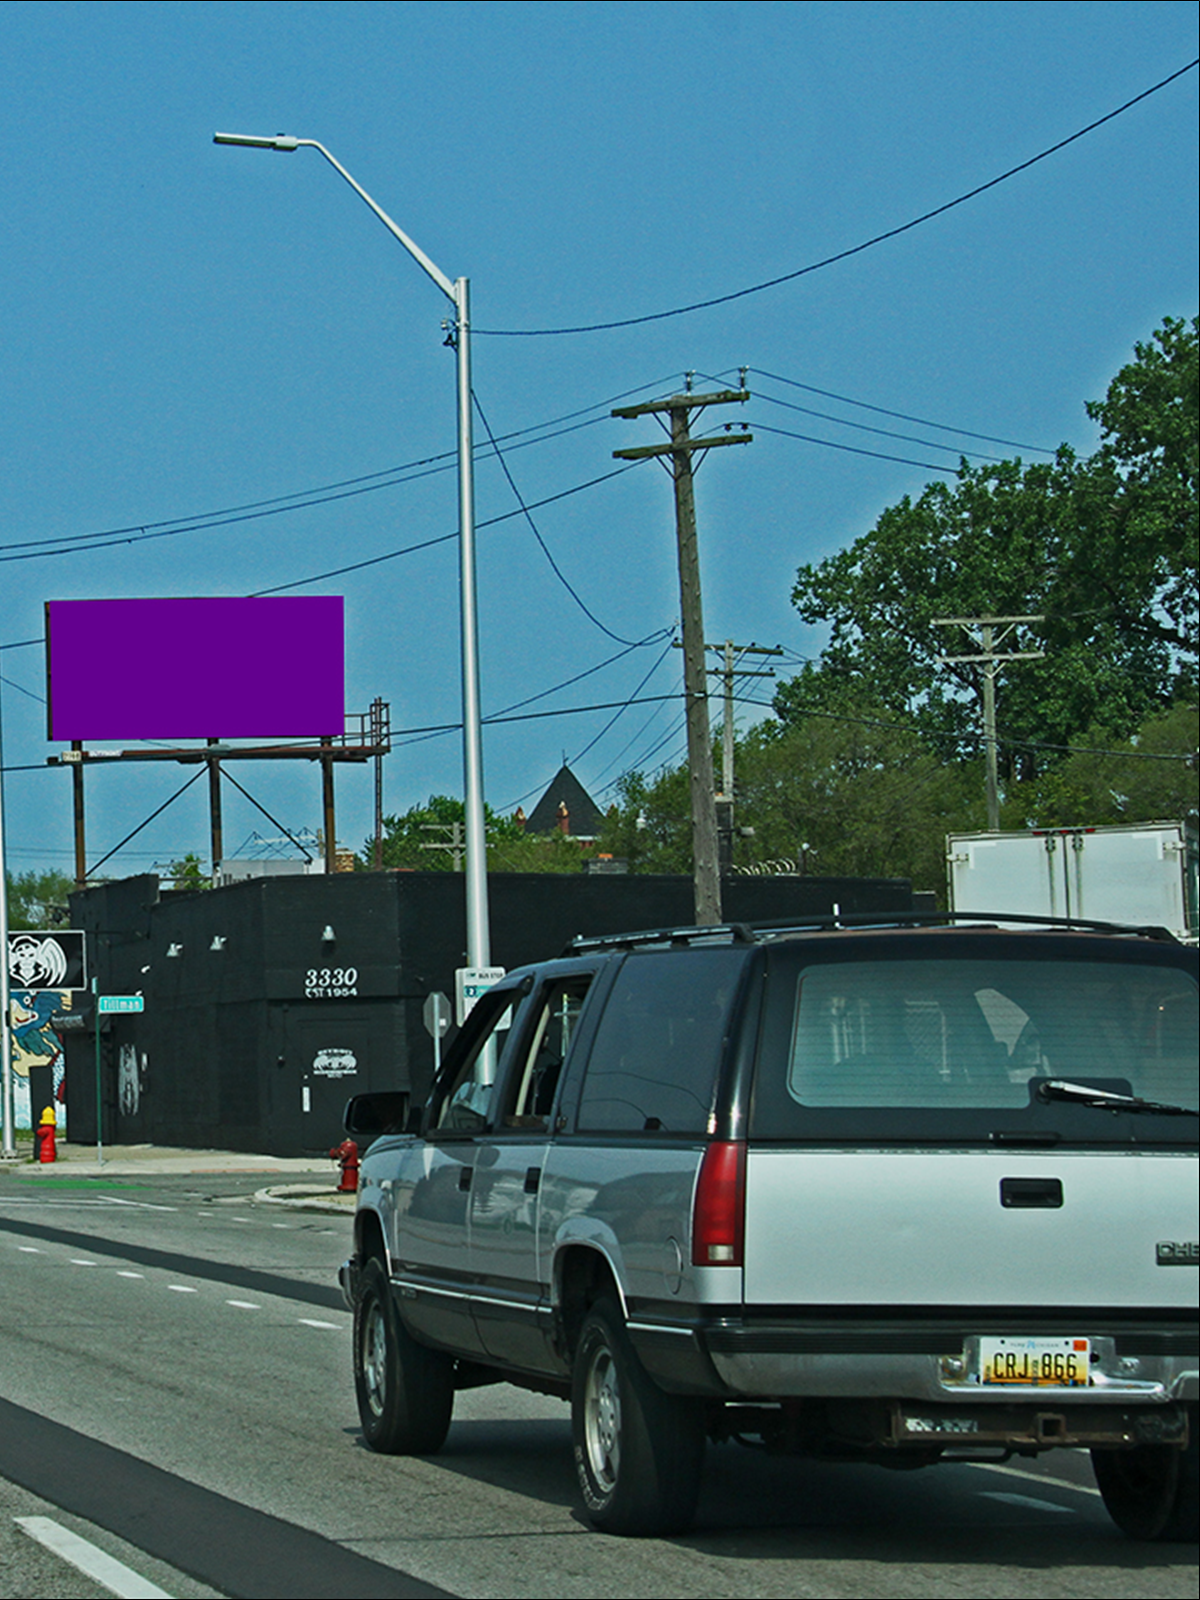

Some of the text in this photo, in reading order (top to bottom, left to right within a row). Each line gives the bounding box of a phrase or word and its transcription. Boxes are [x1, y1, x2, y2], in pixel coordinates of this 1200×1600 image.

[305, 967, 358, 988] 3330
[326, 987, 358, 998] 1954
[103, 999, 140, 1010] Tillman
[993, 1352, 1028, 1379] CRJ
[1041, 1352, 1077, 1379] 866
